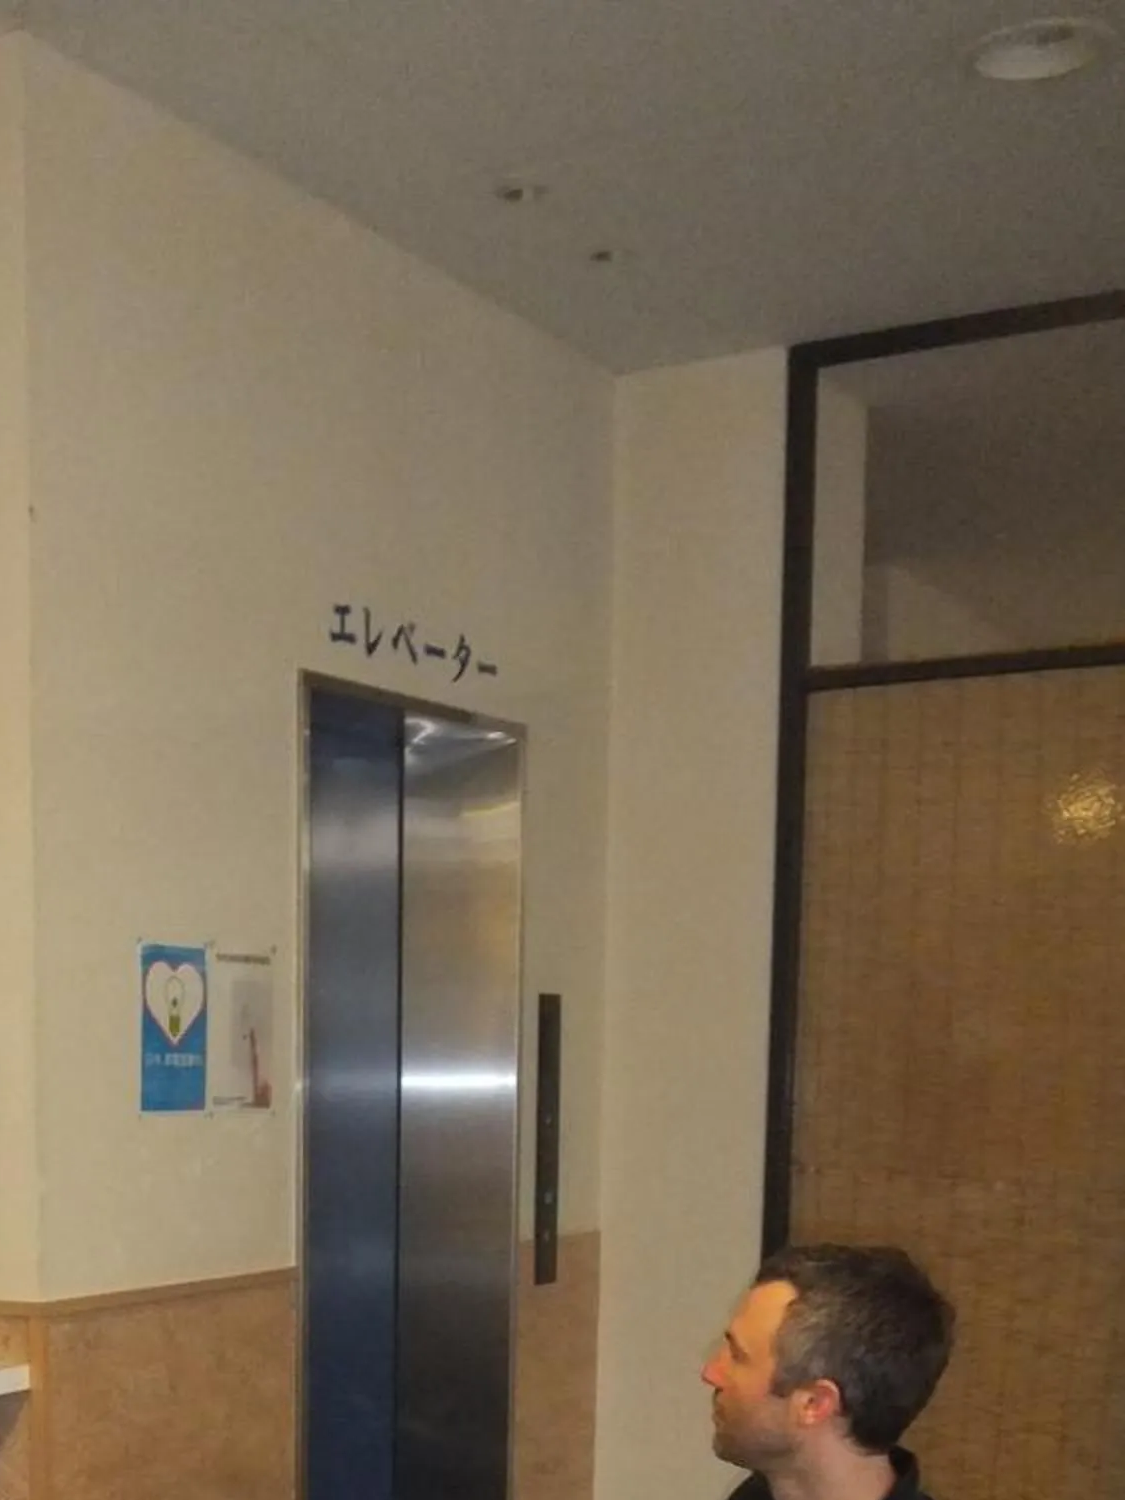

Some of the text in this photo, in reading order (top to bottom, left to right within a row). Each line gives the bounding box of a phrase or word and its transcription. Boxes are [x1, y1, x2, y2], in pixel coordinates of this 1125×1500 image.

[330, 604, 498, 683] エレベーター
